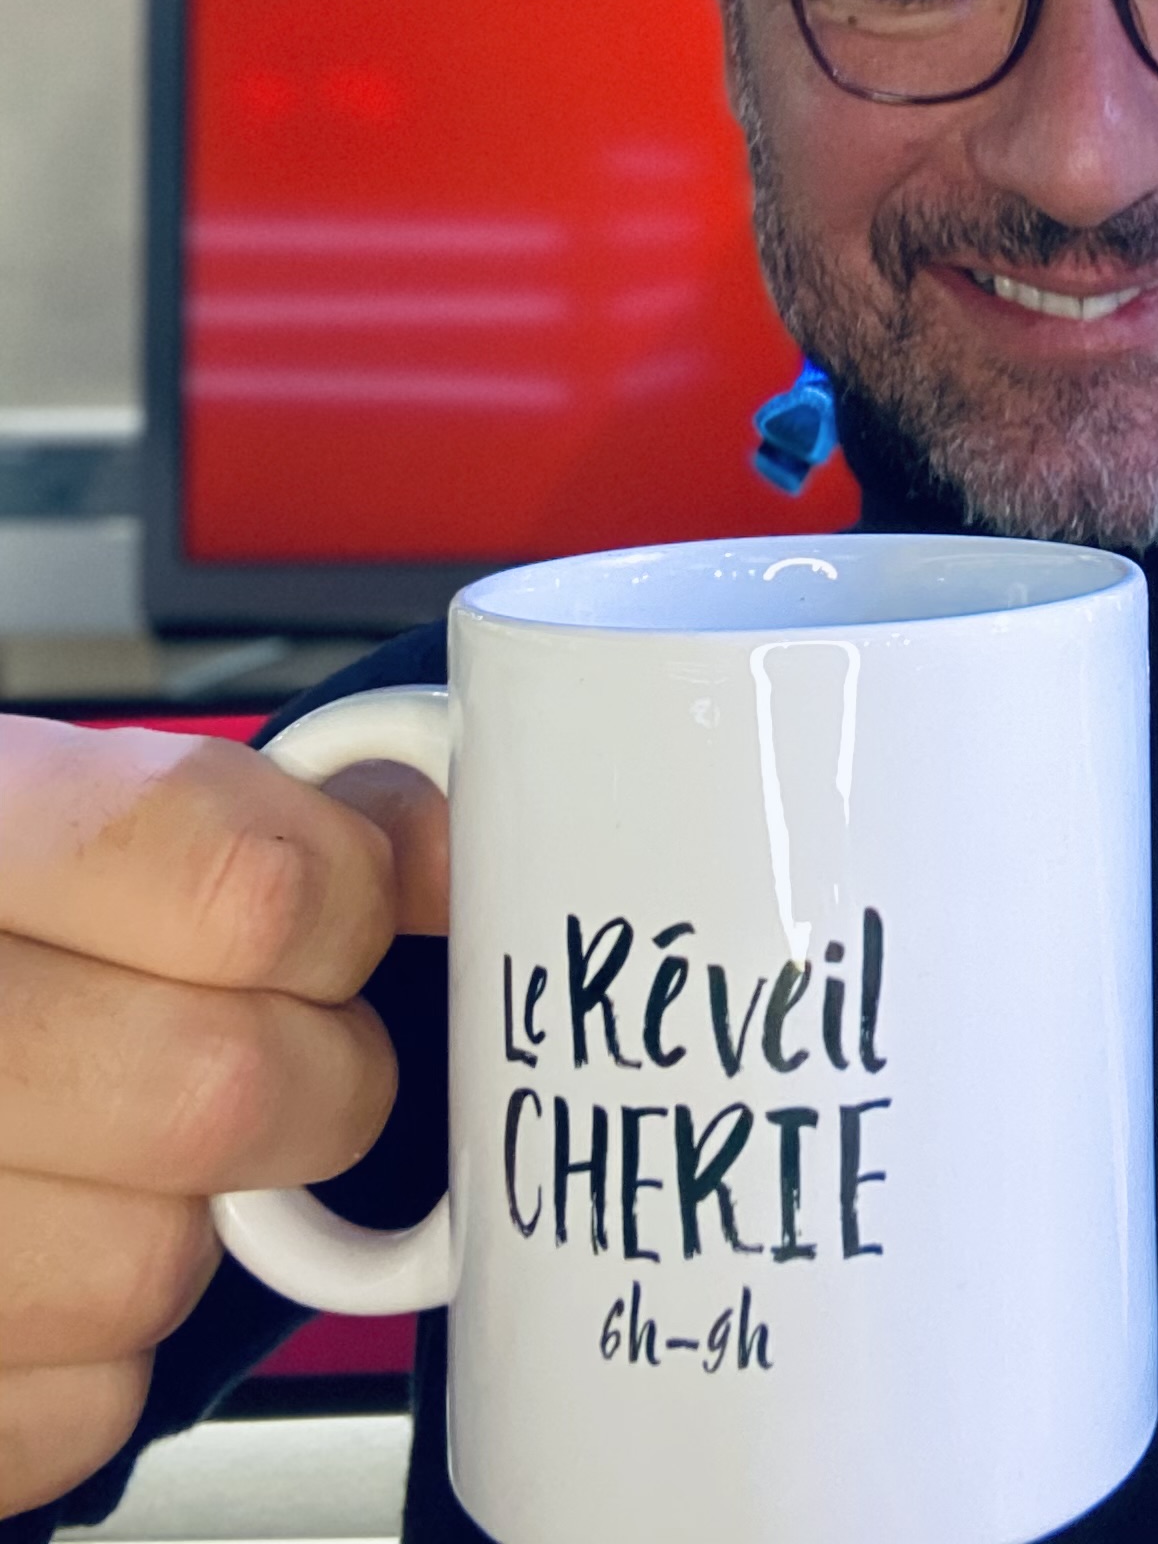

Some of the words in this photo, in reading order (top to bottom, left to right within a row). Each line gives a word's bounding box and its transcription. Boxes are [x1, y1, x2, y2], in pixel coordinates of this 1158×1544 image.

[503, 954, 548, 1068] Le
[567, 906, 888, 1078] Réveil
[504, 1087, 892, 1264] CHERIE
